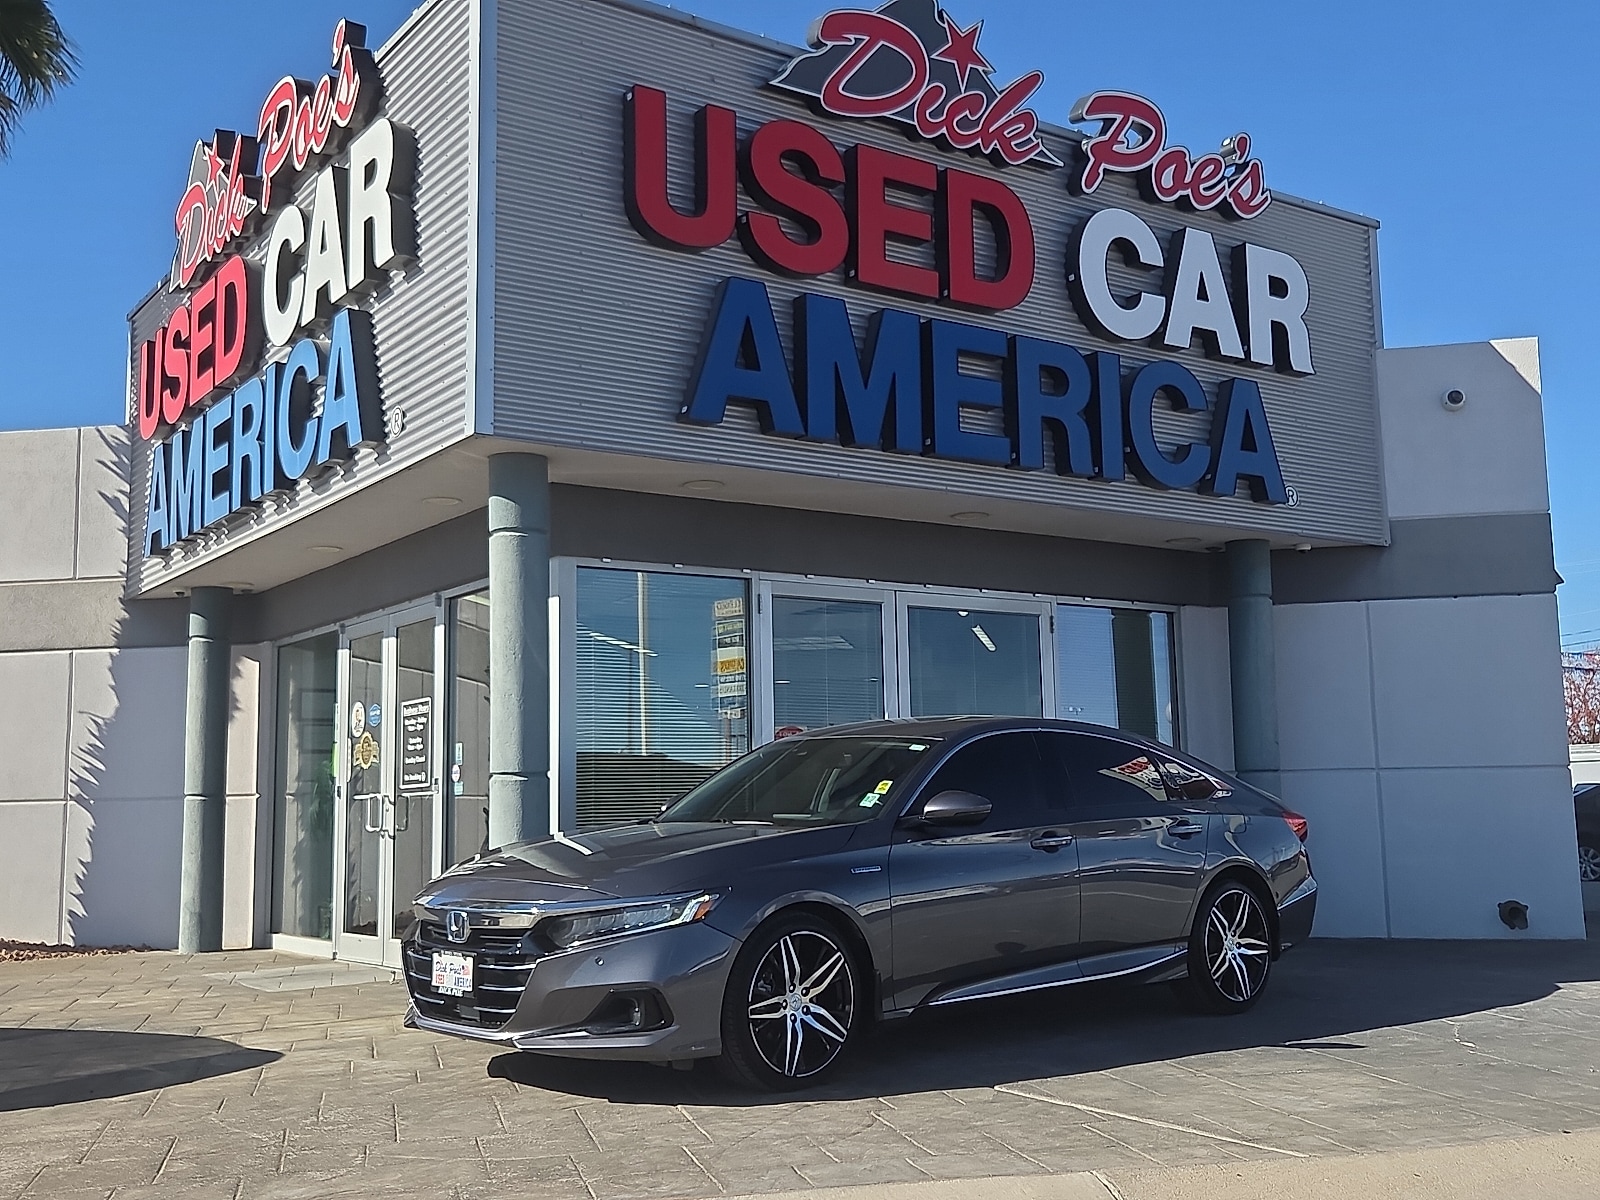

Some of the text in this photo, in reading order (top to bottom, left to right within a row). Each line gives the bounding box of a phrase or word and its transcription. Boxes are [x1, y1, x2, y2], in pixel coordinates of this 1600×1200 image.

[174, 18, 362, 286] Dick Poe's
[628, 85, 1314, 374] USED CAR
[817, 9, 1271, 219] Dick Poe's
[138, 118, 397, 441] USED CAR
[685, 277, 1287, 505] AMERICA
[145, 309, 363, 558] AMERICA
